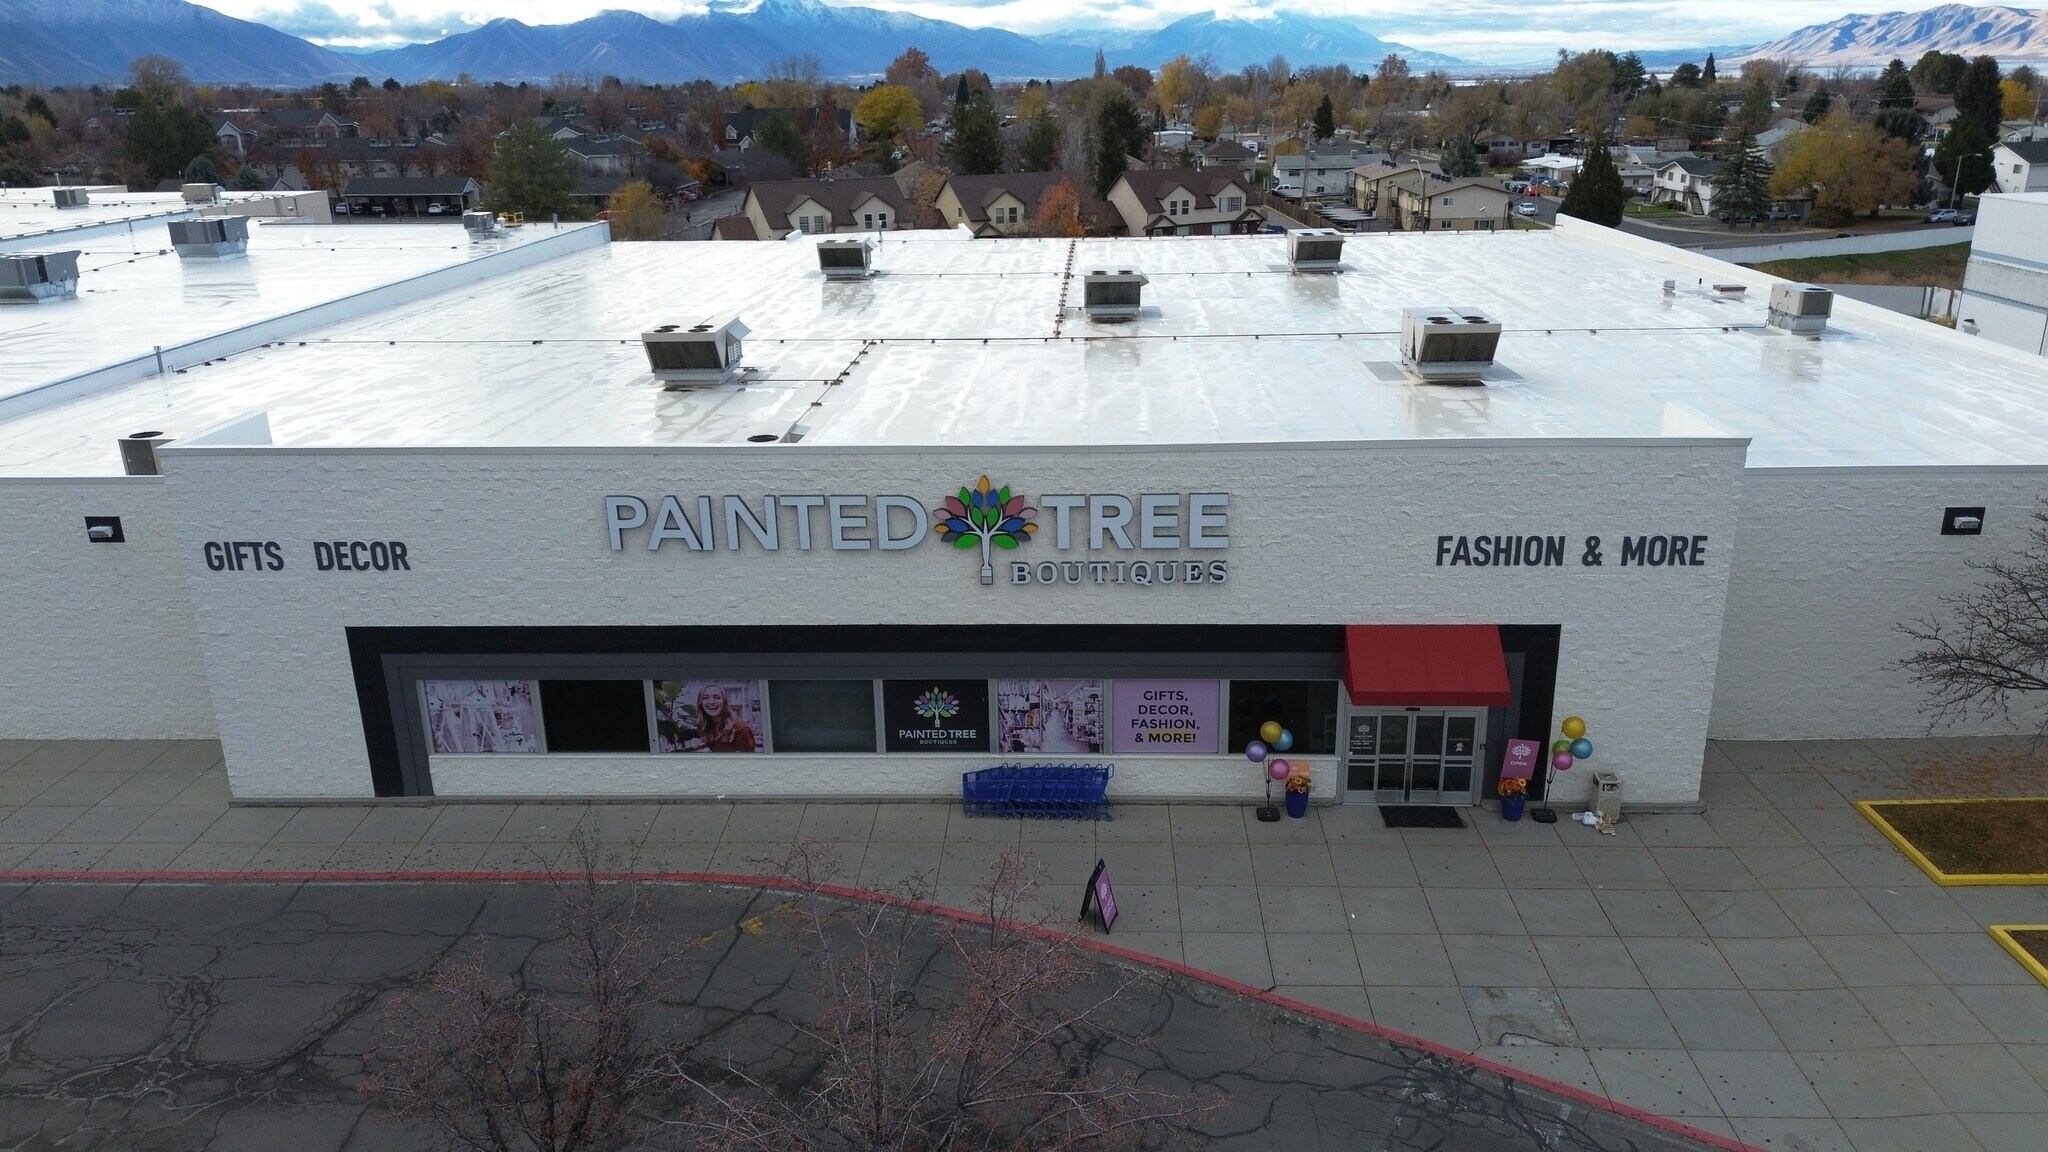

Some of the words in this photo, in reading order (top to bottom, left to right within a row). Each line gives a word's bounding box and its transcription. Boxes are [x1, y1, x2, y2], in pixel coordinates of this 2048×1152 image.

[605, 494, 929, 551] PAINTED
[1040, 492, 1230, 550] TREE
[203, 541, 285, 571] GIFTS
[312, 541, 412, 571] DECOR
[1435, 535, 1566, 567] FASHION
[1581, 535, 1604, 567] &
[1620, 535, 1708, 566] MORE
[1010, 559, 1229, 587] BOUTIQUES
[1143, 690, 1188, 702] GIFTS,
[1138, 705, 1193, 716] DECOR,
[1131, 719, 1200, 730] FASHION,
[899, 729, 947, 738] PAINTED
[948, 729, 976, 738] TREE
[1134, 733, 1144, 743] &
[1148, 733, 1196, 743] MORE!
